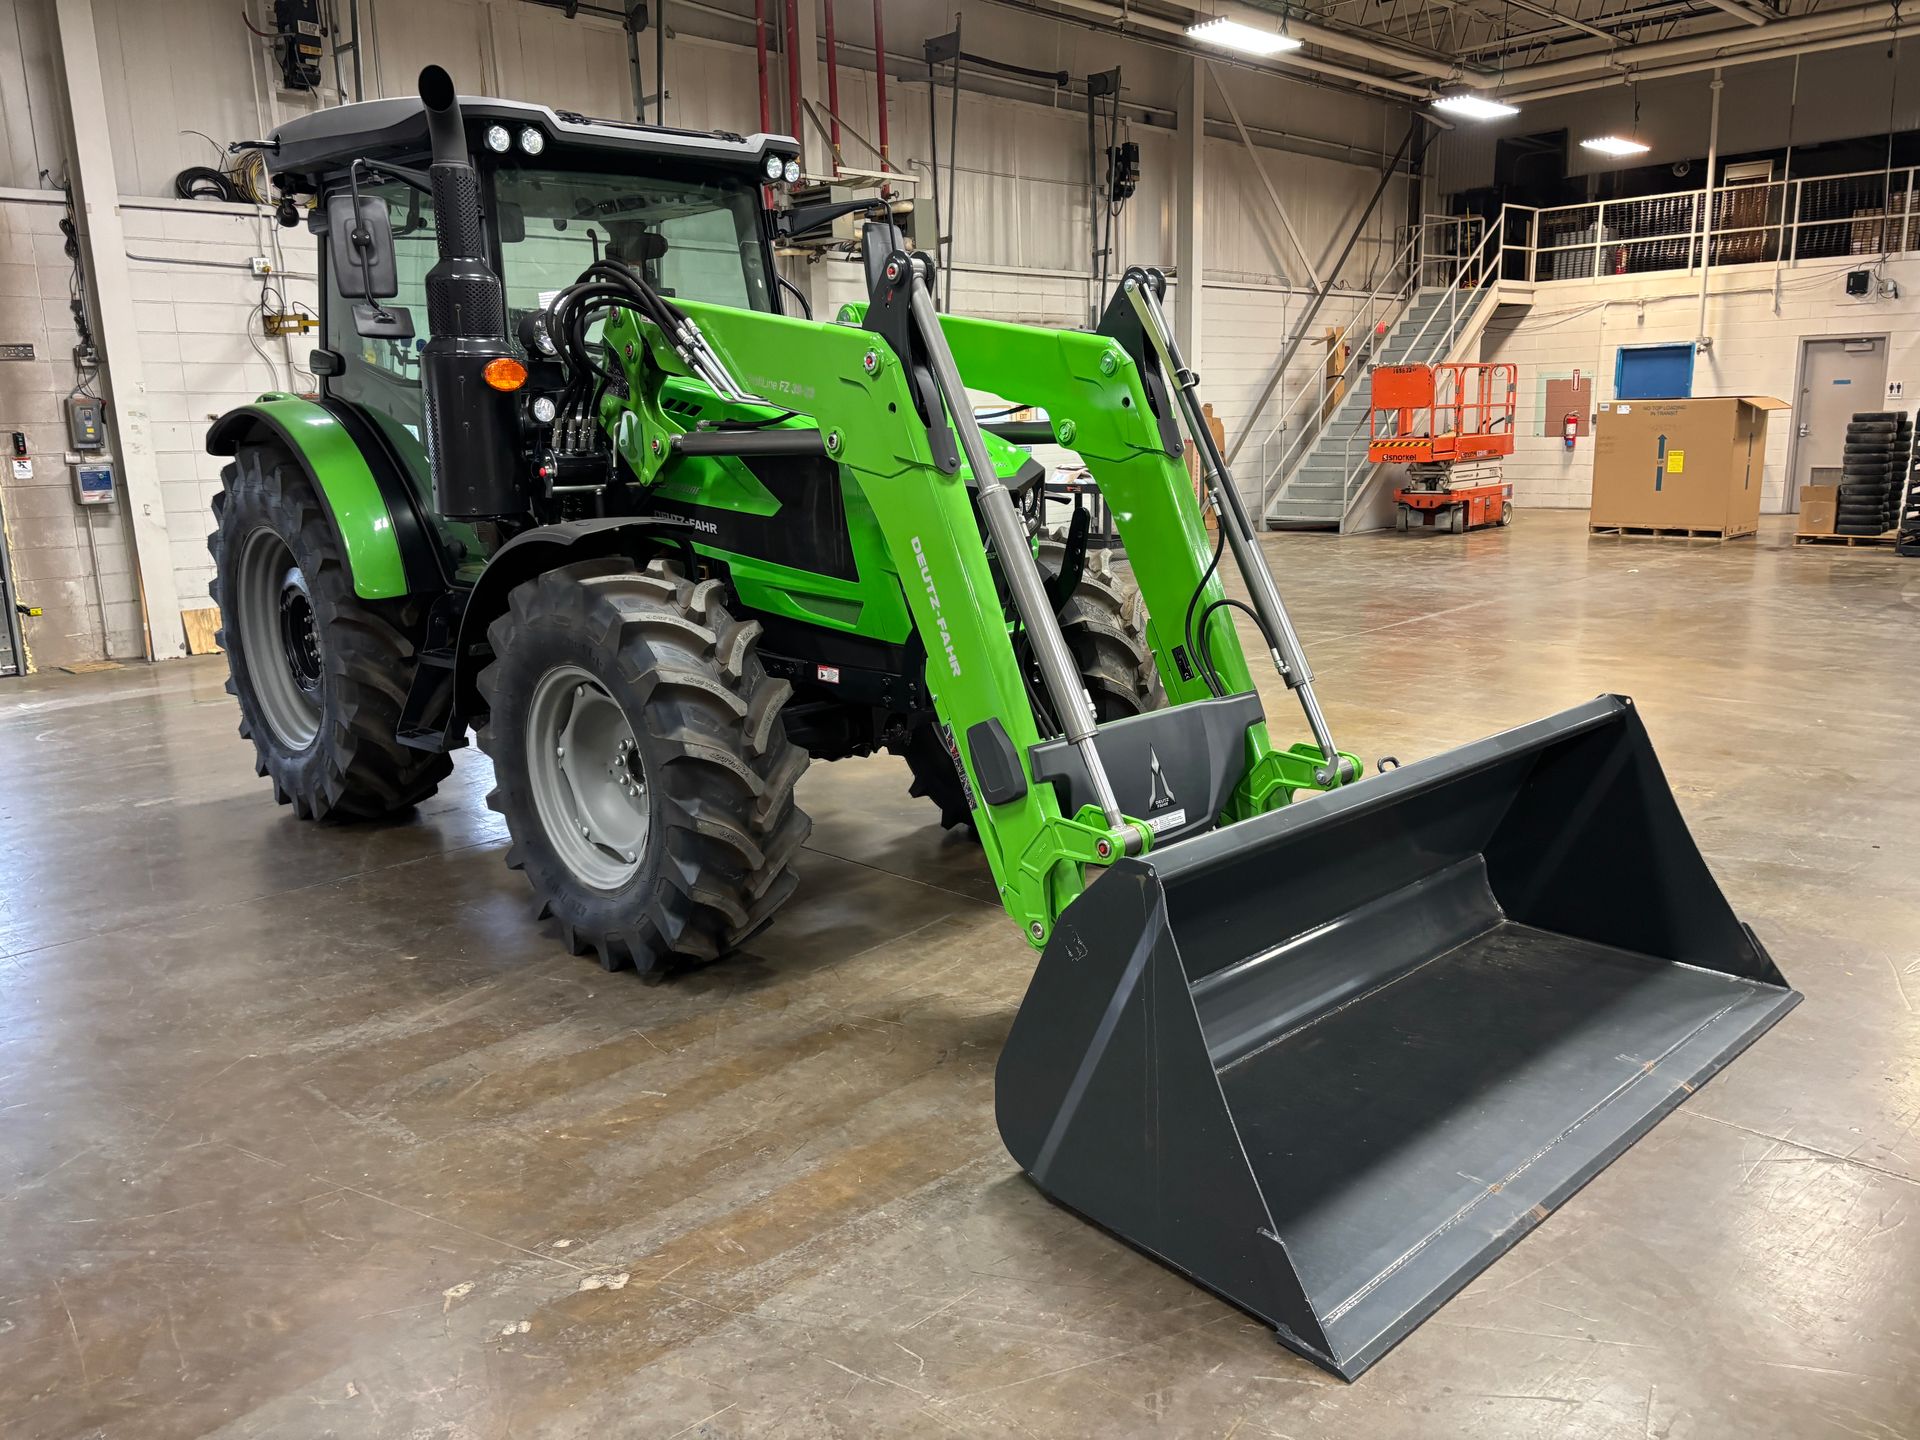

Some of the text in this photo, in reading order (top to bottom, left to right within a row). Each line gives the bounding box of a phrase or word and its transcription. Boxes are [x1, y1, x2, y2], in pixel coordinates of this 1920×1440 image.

[779, 380, 790, 393] FZ
[1389, 453, 1417, 461] snorkel
[910, 536, 961, 677] DEUTZ-FAHR
[1155, 797, 1170, 805] DEUTZ
